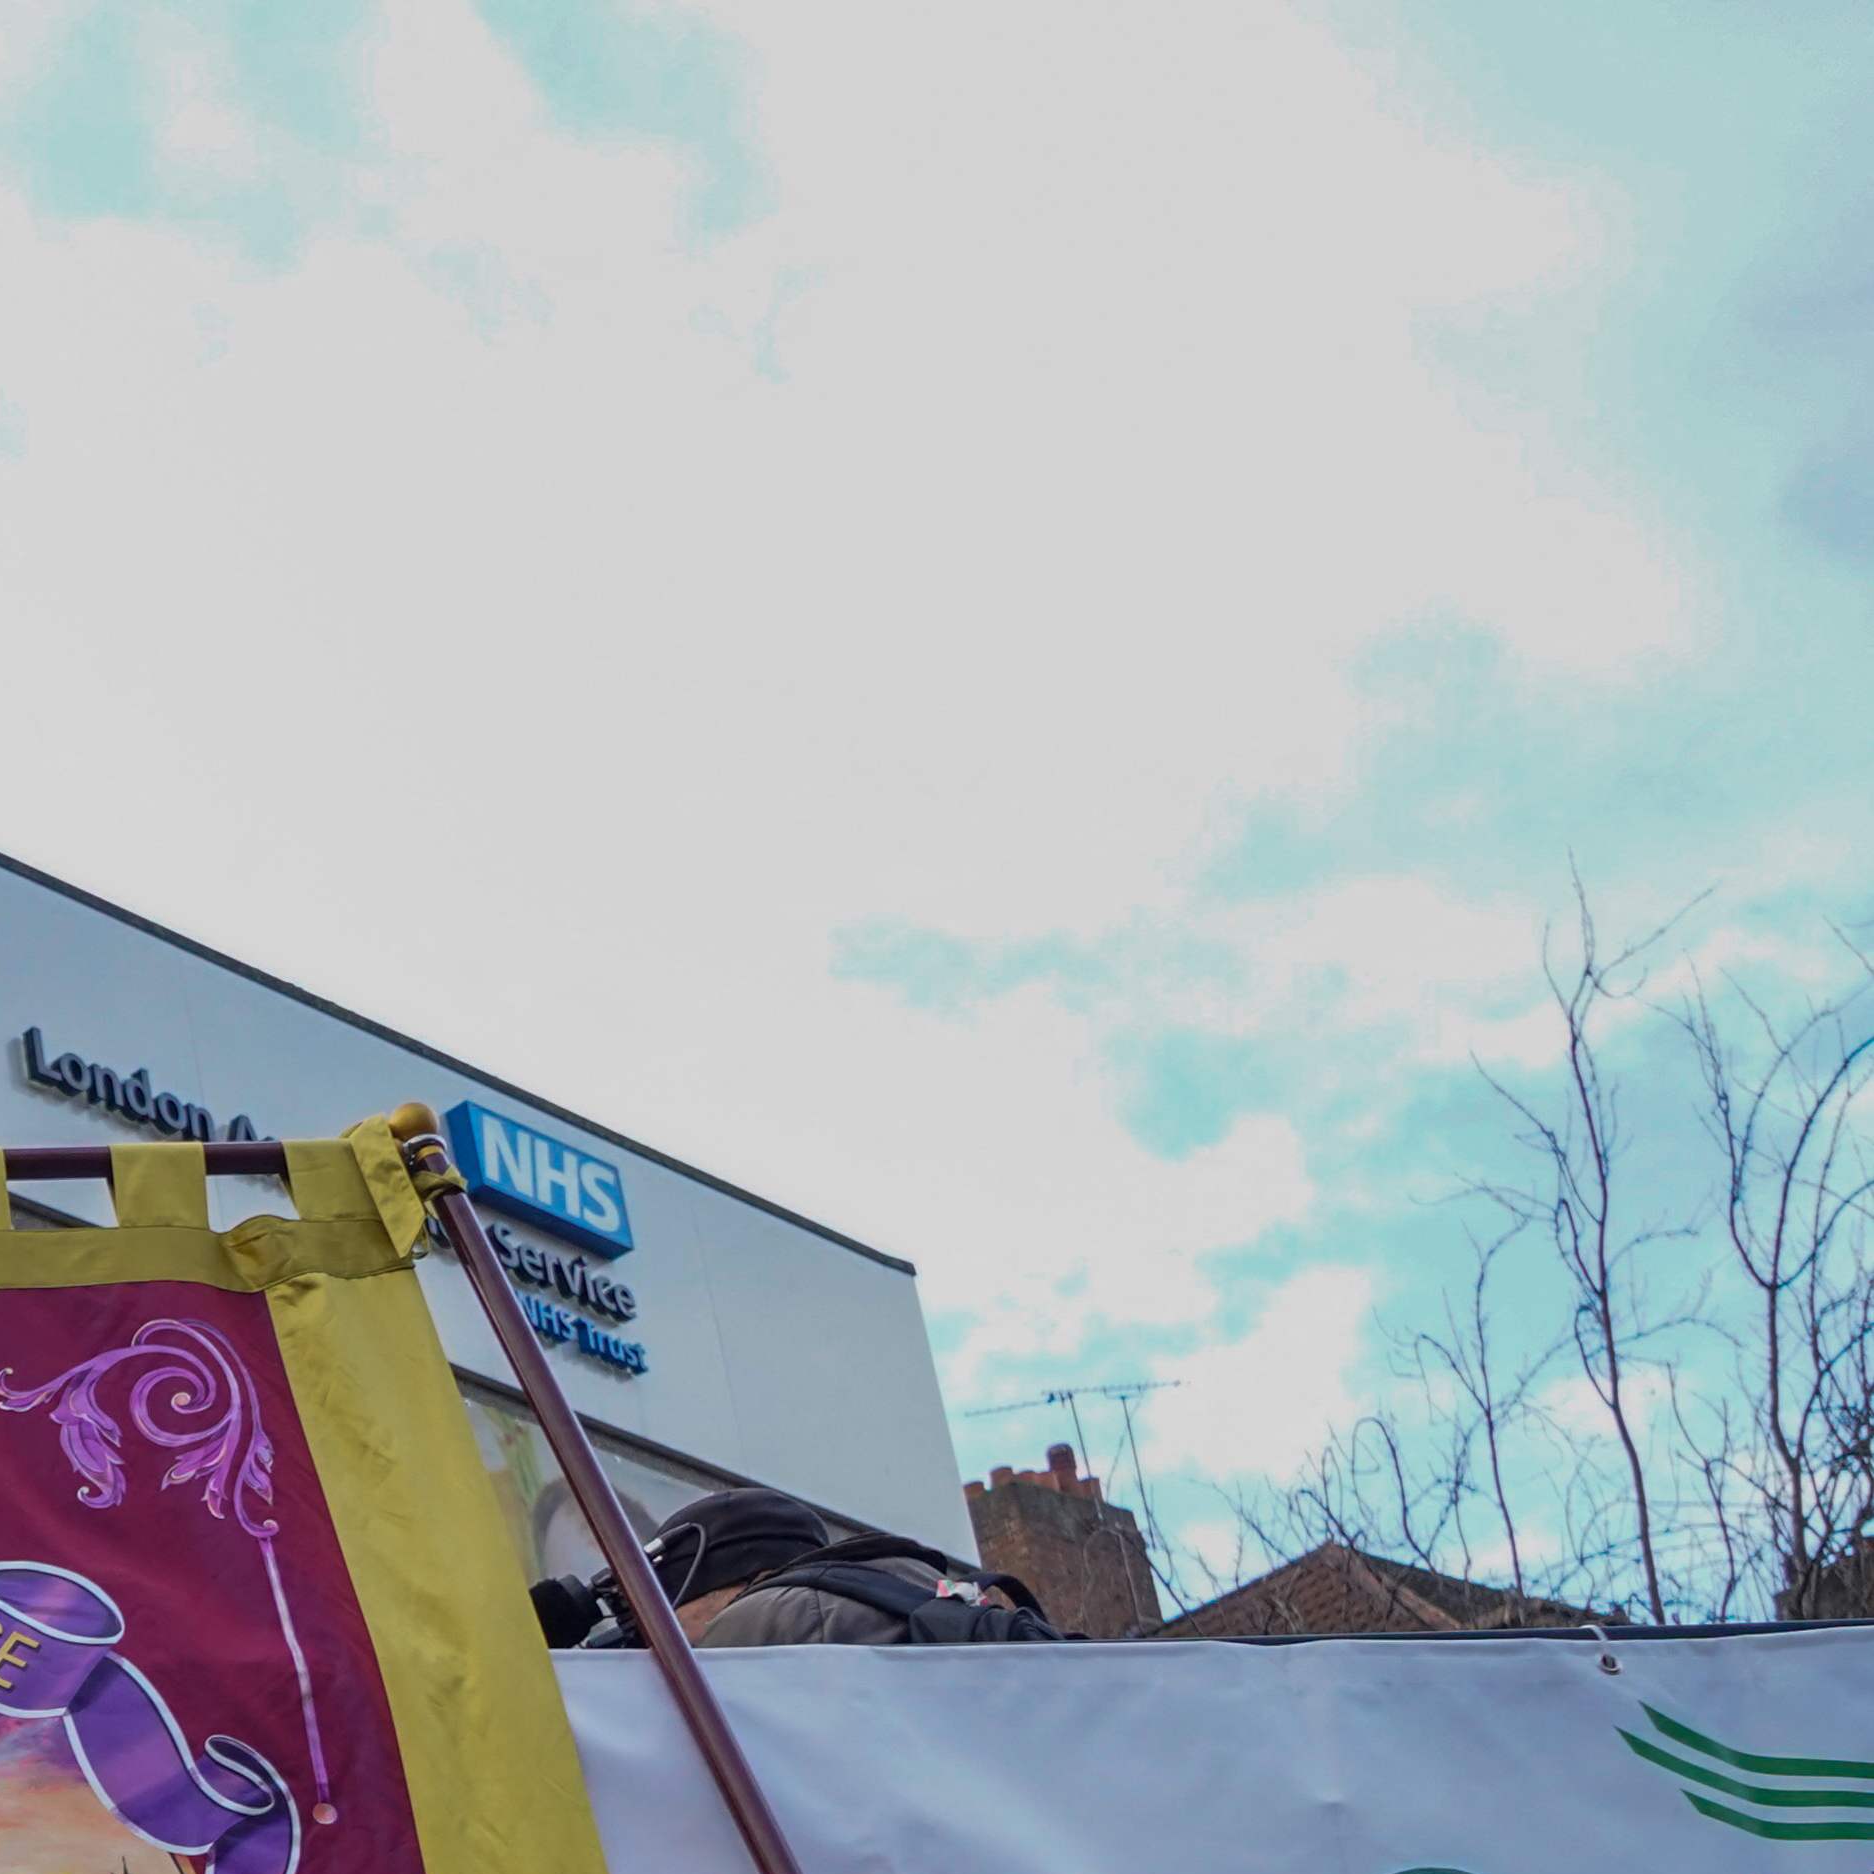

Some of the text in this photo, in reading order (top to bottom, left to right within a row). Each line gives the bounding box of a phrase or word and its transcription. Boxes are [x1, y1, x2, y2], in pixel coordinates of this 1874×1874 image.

[23, 1026, 212, 1142] London
[484, 1125, 621, 1232] NHS
[489, 1221, 637, 1322] Service
[517, 1290, 648, 1374] NHS Trust
